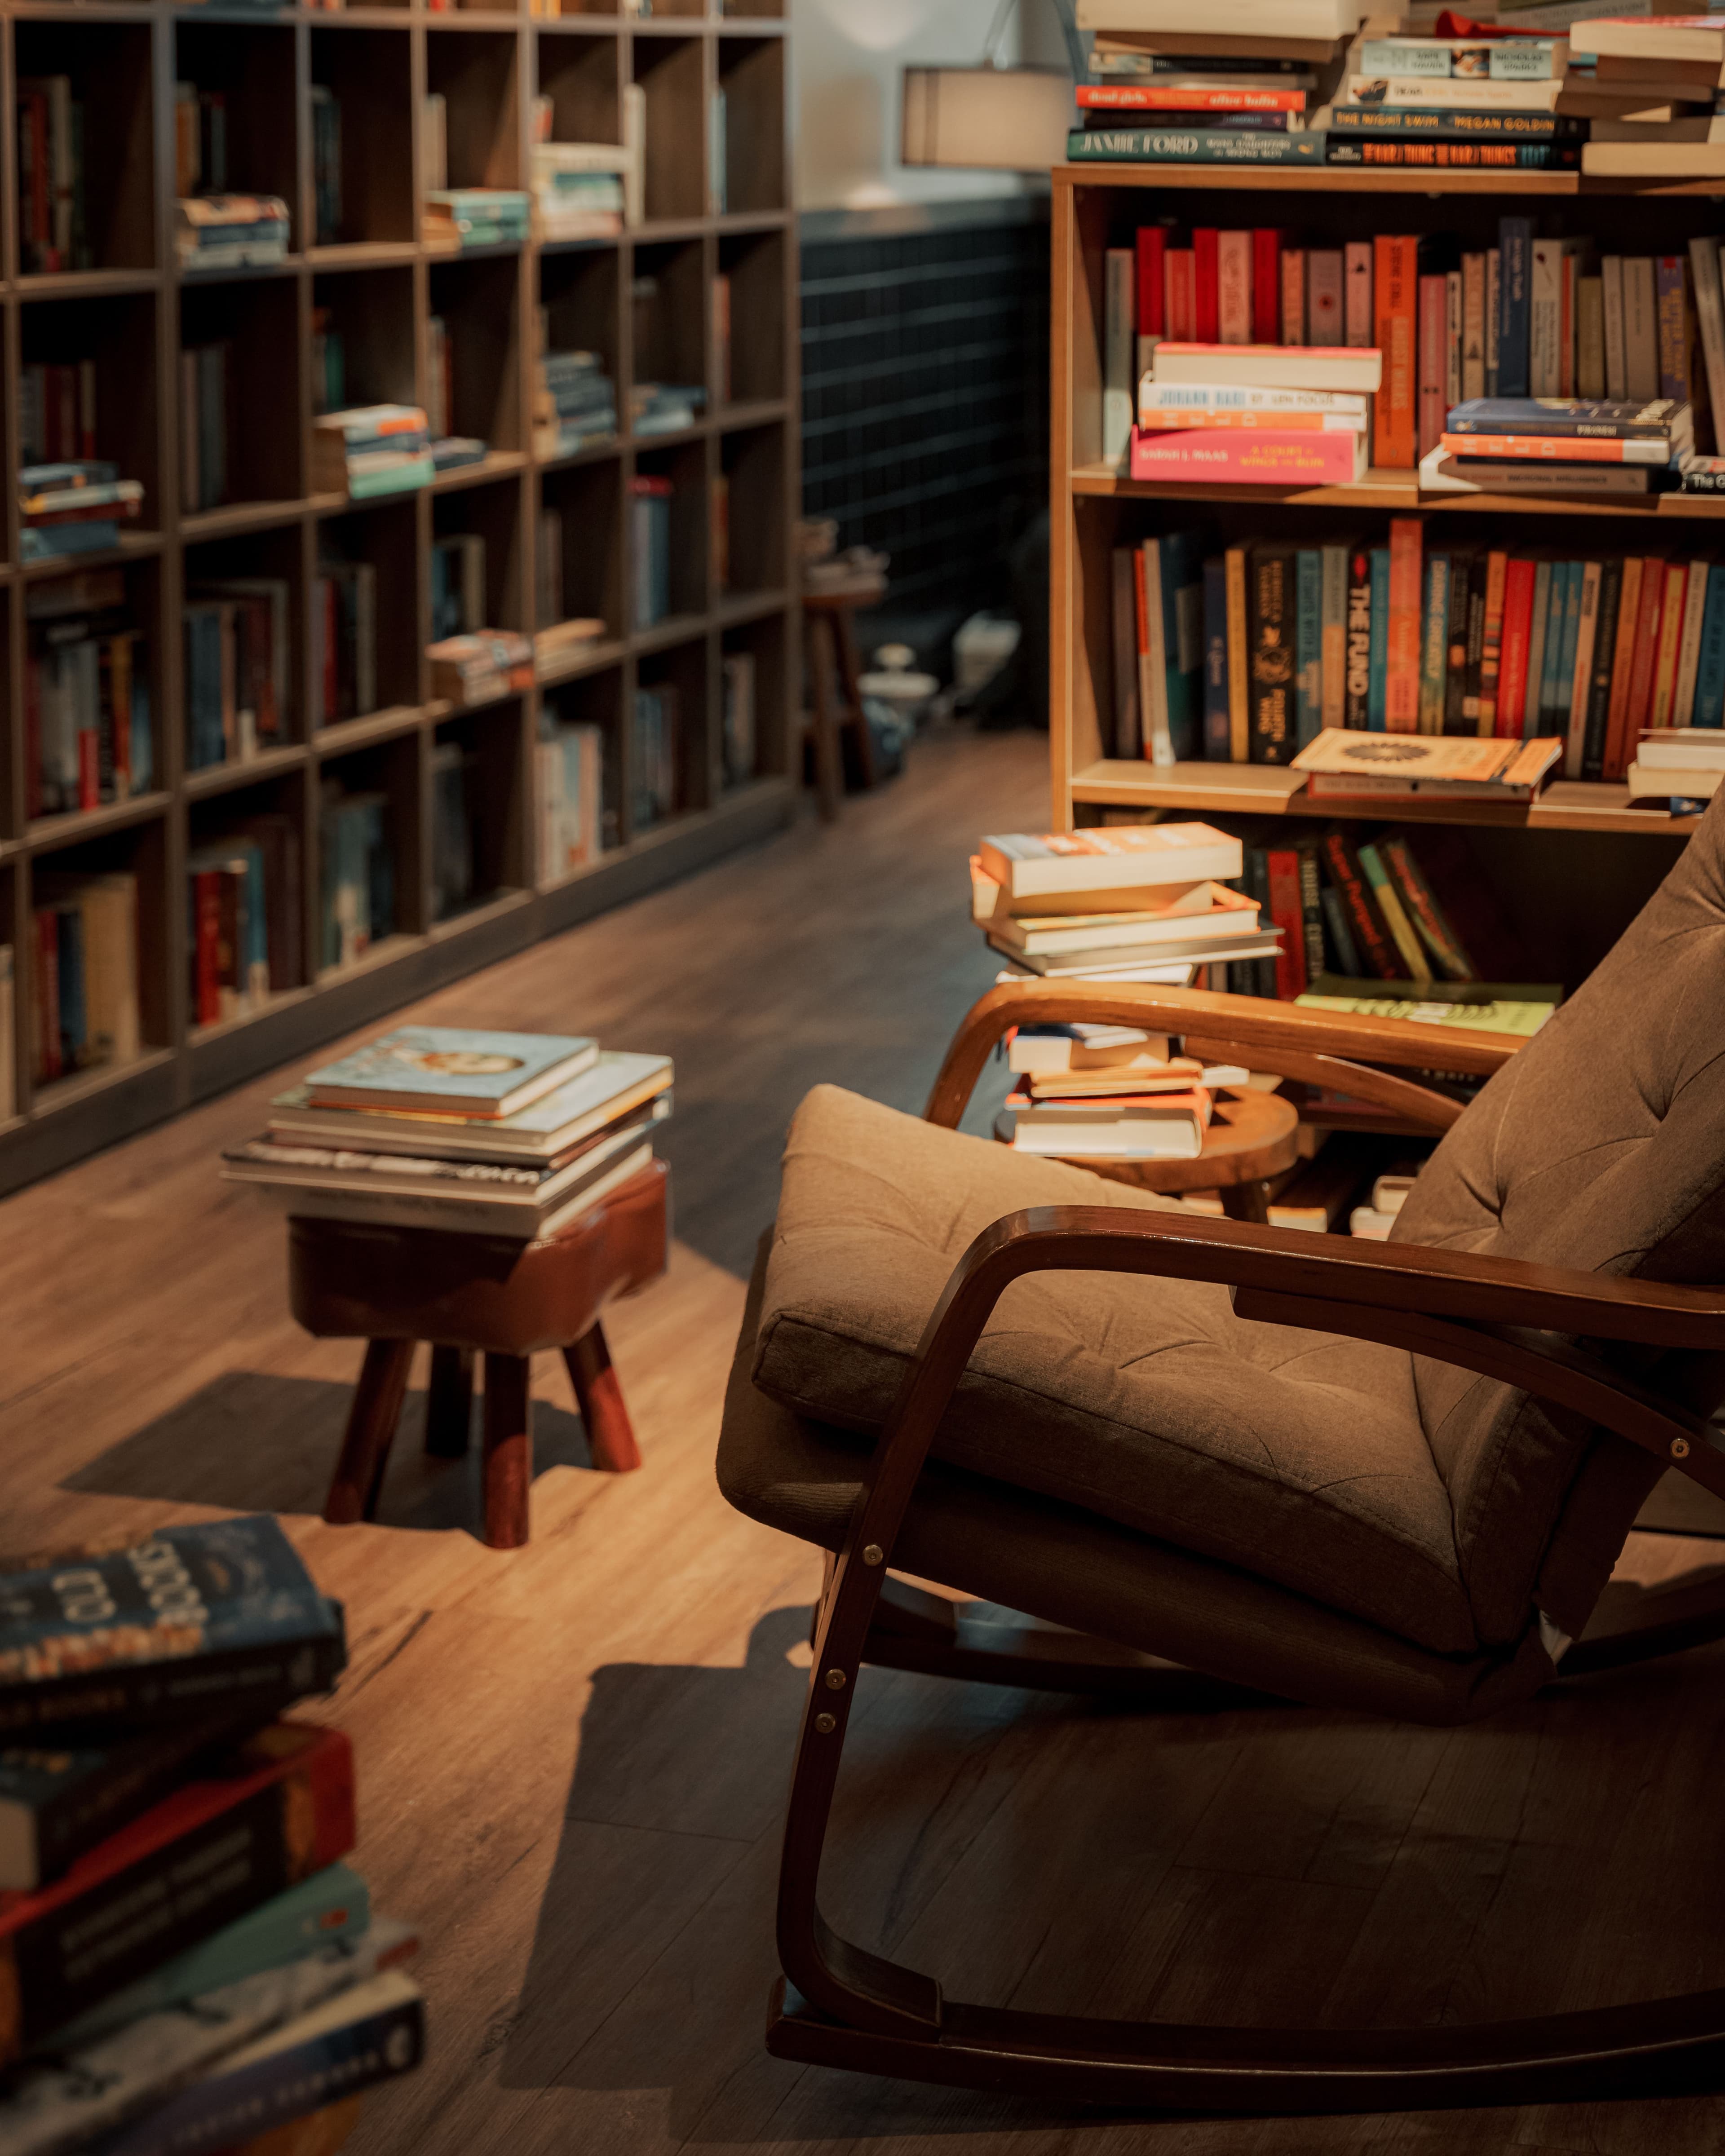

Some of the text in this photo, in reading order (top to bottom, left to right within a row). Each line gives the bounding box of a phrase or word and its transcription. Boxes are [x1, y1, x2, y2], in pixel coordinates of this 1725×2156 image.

[1336, 112, 1439, 128] THE NIGHT SWIM
[1454, 116, 1555, 131] MEGAN GOLDIN
[1143, 135, 1199, 155] FORD
[1691, 474, 1715, 489] The
[1349, 584, 1370, 631] THE
[1348, 632, 1370, 696] FUND
